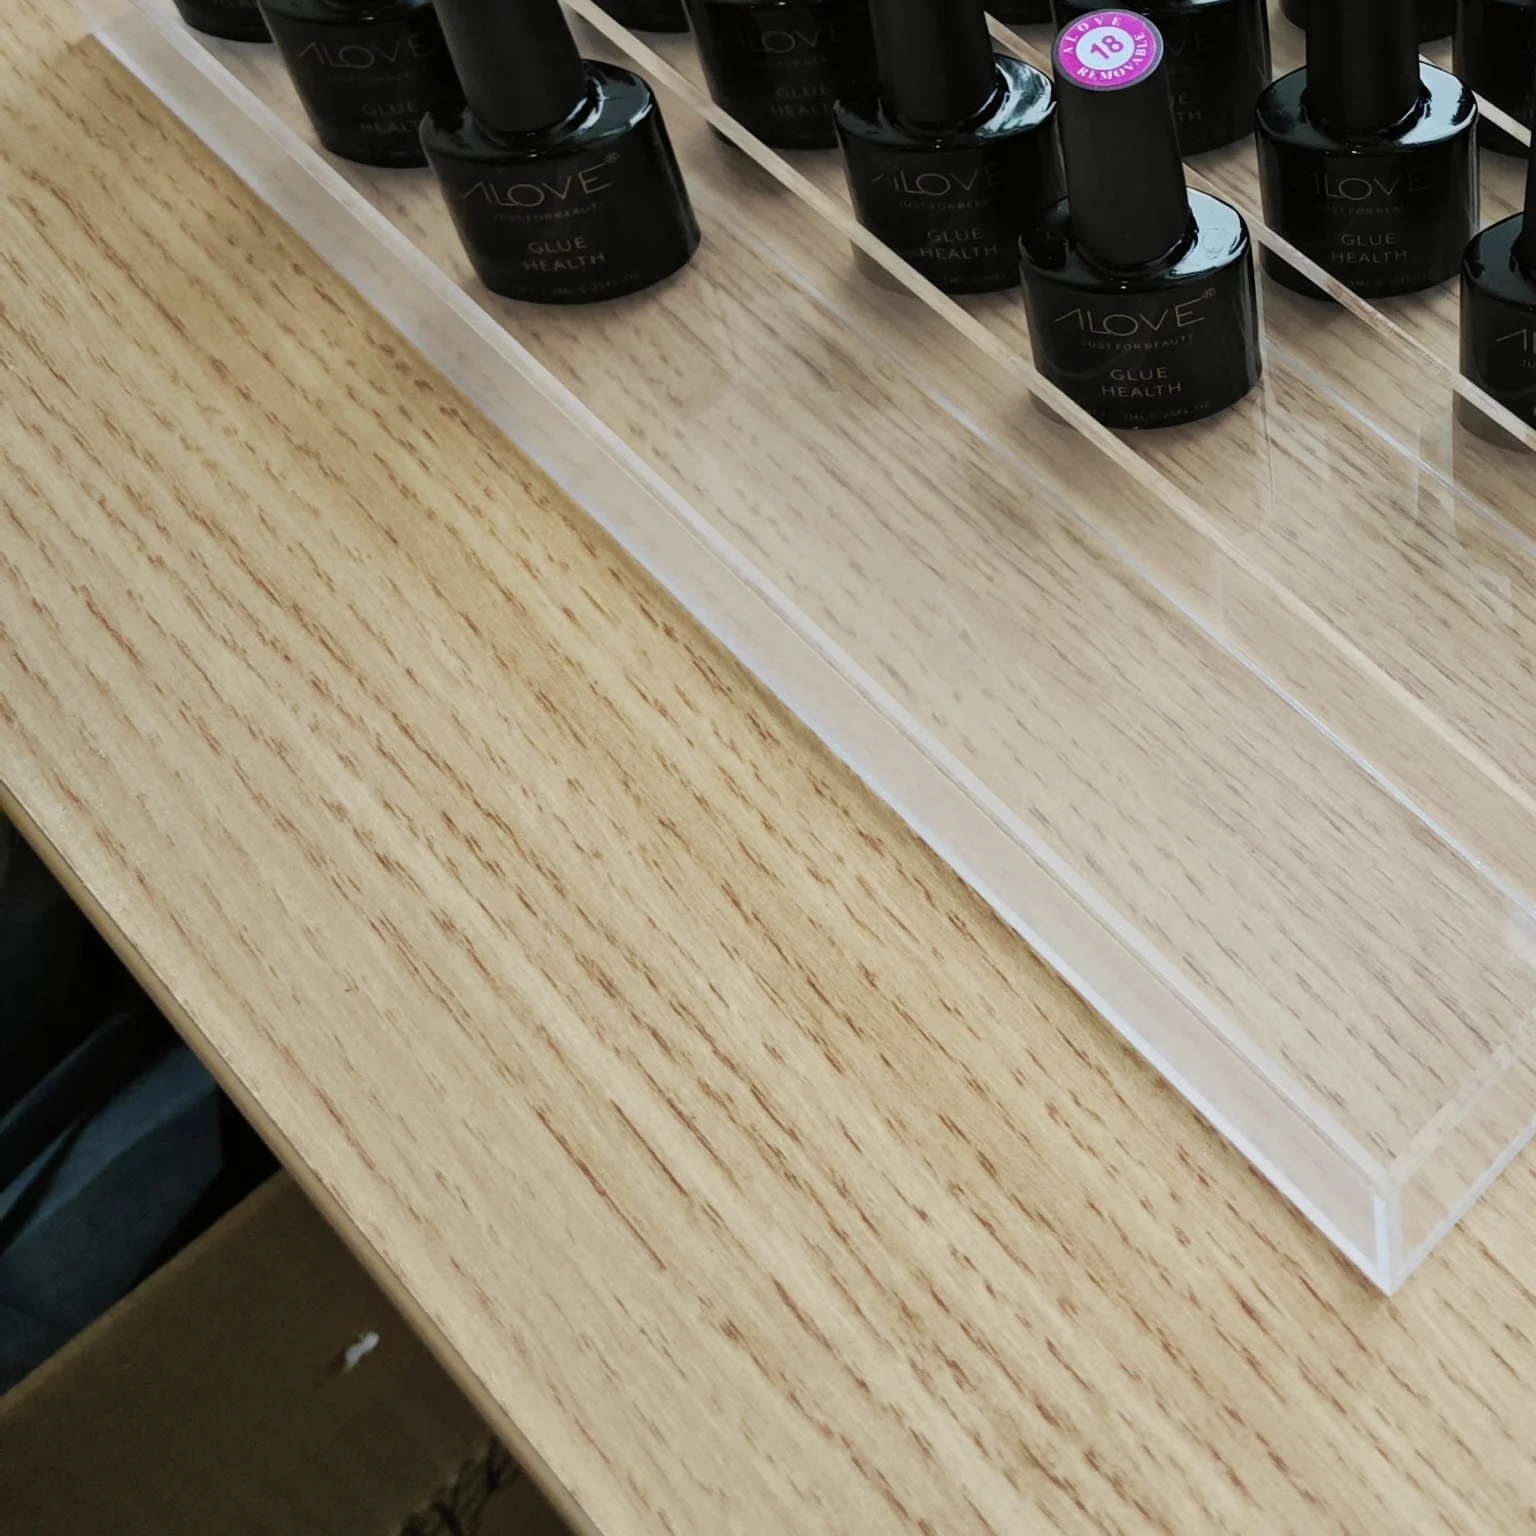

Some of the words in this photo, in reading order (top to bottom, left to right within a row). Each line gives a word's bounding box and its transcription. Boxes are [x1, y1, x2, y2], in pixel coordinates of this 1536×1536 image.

[1063, 16, 1122, 54] ALOVE
[1090, 35, 1125, 59] 18
[1077, 32, 1147, 80] REMOVABLE
[927, 227, 983, 243] GLUE
[1341, 234, 1397, 246] GLUE
[528, 237, 587, 254] GLUE
[920, 245, 997, 260] HEALTH
[522, 252, 605, 271] HEALTH
[1331, 250, 1407, 263] HEALTH
[1116, 343, 1140, 351] FOR
[1110, 367, 1169, 381] GLUE
[1101, 381, 1181, 398] HEALTH
